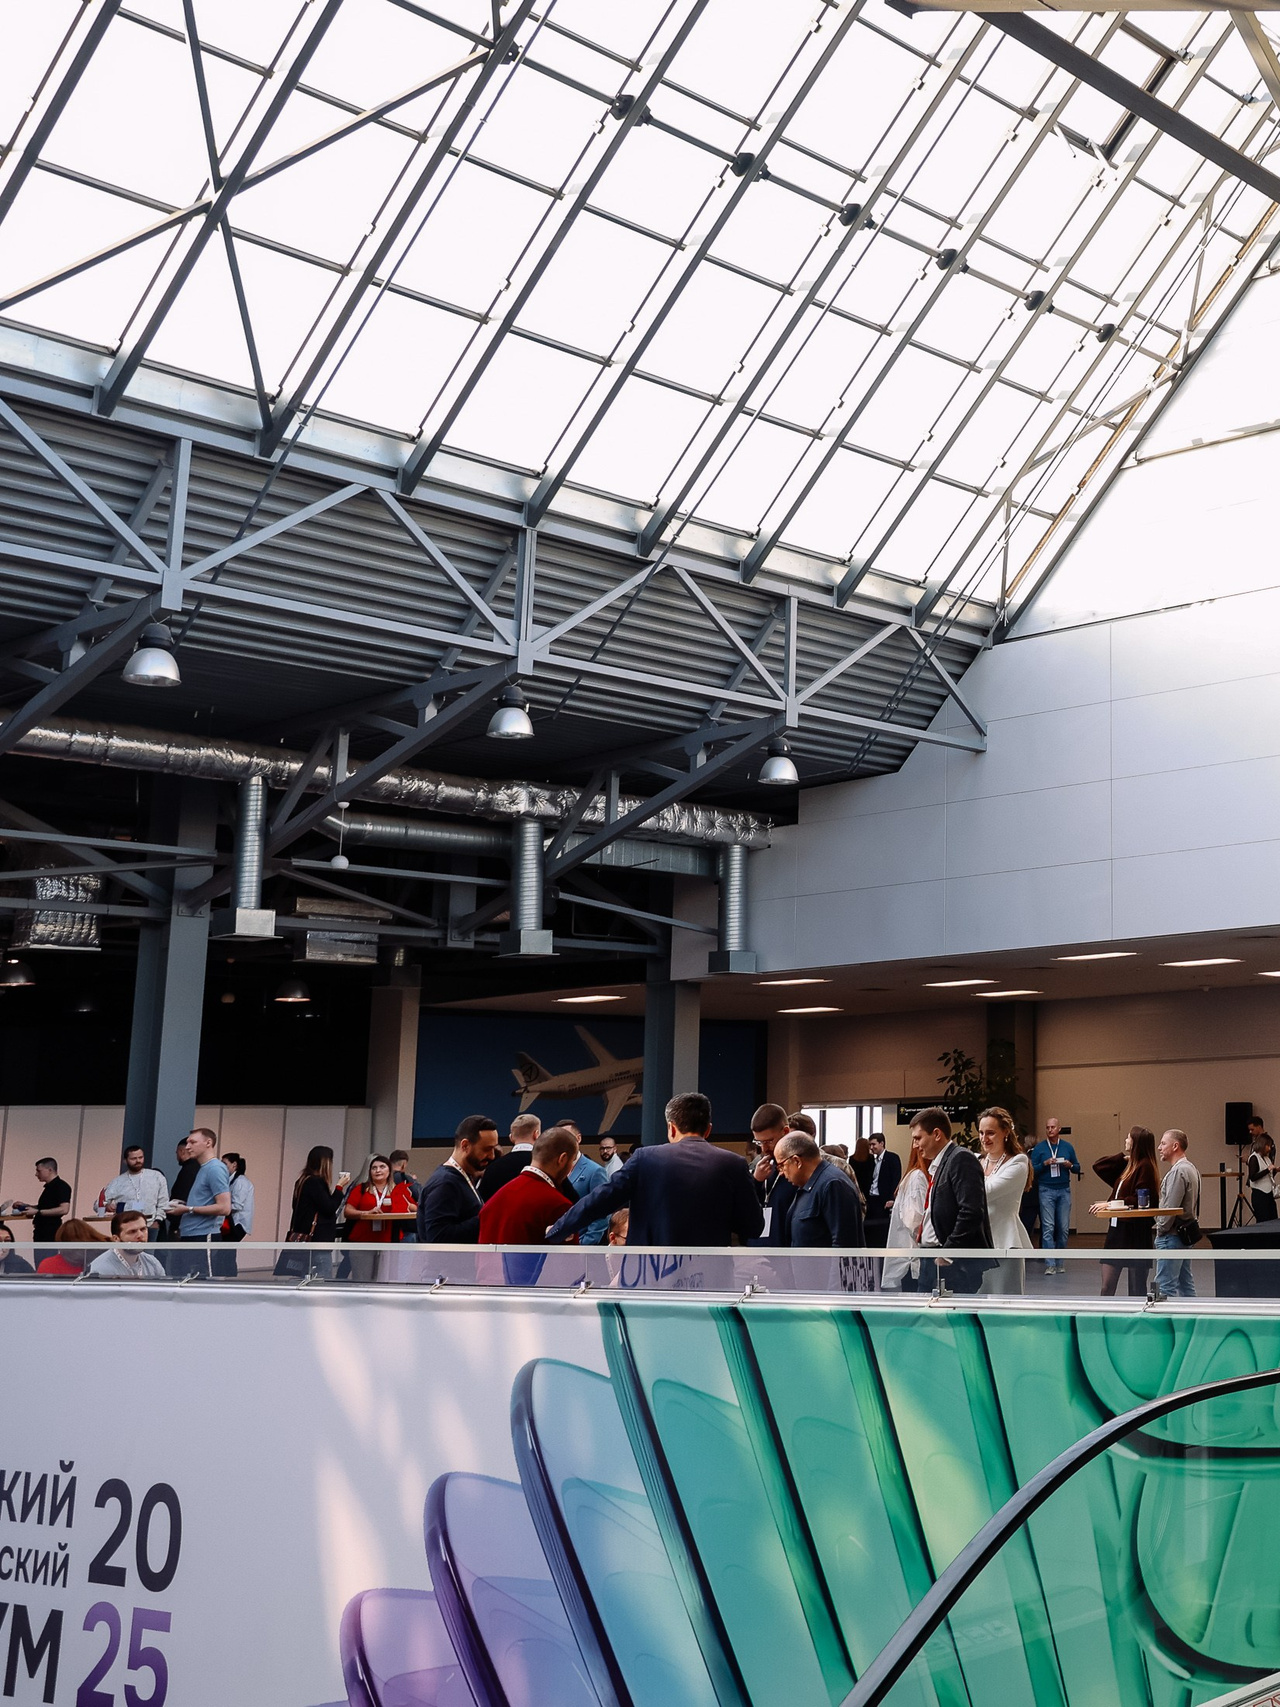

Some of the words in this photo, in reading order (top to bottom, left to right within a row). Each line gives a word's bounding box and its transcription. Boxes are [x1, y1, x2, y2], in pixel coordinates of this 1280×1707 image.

[88, 1478, 182, 1592] 20
[0, 1603, 64, 1704] М
[76, 1601, 172, 1707] 25
